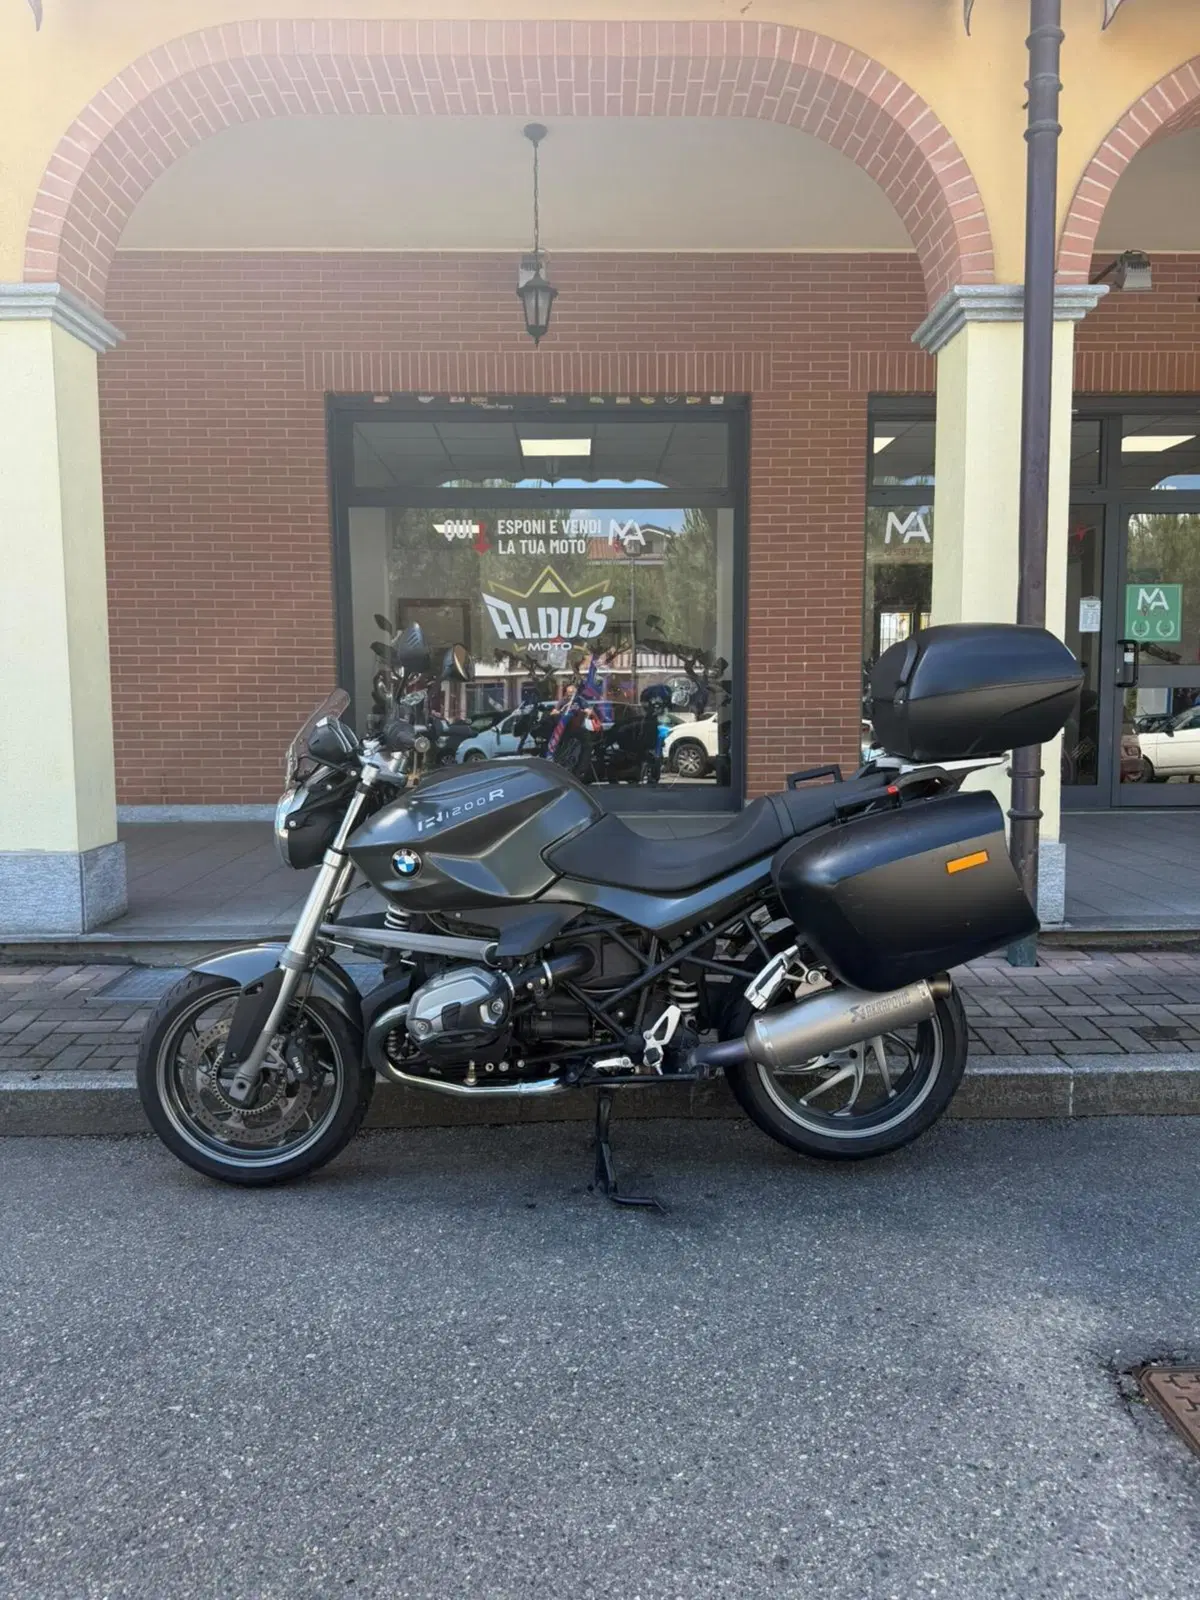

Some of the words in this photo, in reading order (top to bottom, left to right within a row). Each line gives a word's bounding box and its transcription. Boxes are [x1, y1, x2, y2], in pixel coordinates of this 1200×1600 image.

[444, 519, 474, 542] QUI
[497, 519, 546, 535] ESPONI
[549, 519, 558, 535] E
[562, 518, 602, 535] VENDI
[608, 518, 647, 547] MA
[884, 511, 931, 544] MA
[498, 539, 515, 555] LA
[519, 539, 545, 555] TUA
[549, 539, 586, 555] MOTO
[1137, 587, 1170, 611] MA
[481, 592, 616, 640] ALDUS
[527, 641, 573, 652] MOTO
